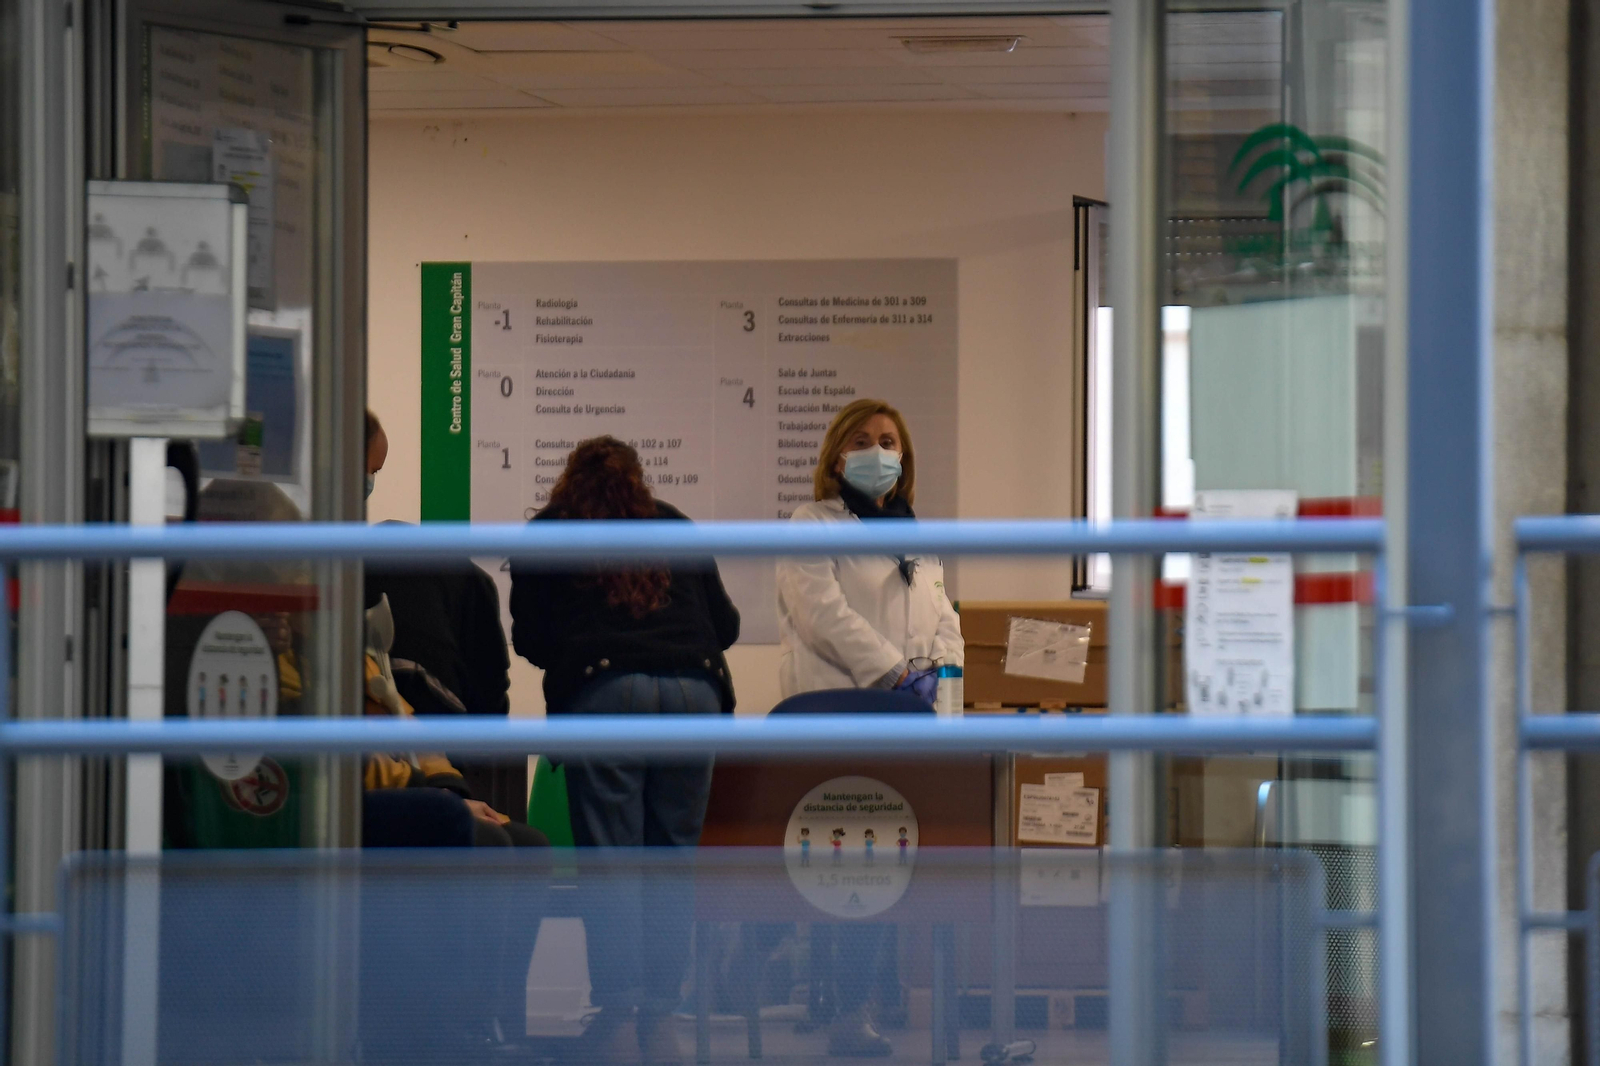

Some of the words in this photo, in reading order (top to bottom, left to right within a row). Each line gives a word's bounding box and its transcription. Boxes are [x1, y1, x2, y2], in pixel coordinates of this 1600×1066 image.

[450, 272, 465, 314] Capitán
[478, 301, 501, 311] Planta
[535, 297, 578, 310] Radiología
[778, 296, 818, 307] Consultas
[820, 296, 830, 307] de
[832, 296, 869, 307] Medicina
[872, 296, 882, 307] de
[884, 296, 900, 307] 301
[902, 299, 908, 307] a
[910, 296, 926, 307] 309
[494, 309, 512, 331] -1
[535, 315, 593, 327] Rehabilitación
[743, 309, 756, 332] 3
[778, 314, 818, 325] Consultas
[820, 314, 830, 325] de
[832, 314, 877, 325] Enfermería
[879, 314, 889, 325] de
[891, 314, 907, 325] 311
[909, 317, 915, 325] a
[917, 314, 932, 325] 314
[450, 316, 462, 342] Gran
[535, 333, 583, 346] Fisioterapia
[778, 331, 830, 343] Extracciones
[450, 347, 462, 377] Salud
[478, 369, 501, 378] Planta
[535, 368, 571, 380] Atención
[573, 371, 579, 380] a
[580, 369, 588, 380] la
[590, 368, 635, 380] Ciudadanía
[778, 367, 796, 379] Sala
[798, 367, 808, 379] de
[810, 367, 837, 379] Juntas
[450, 380, 462, 394] de
[500, 376, 513, 398] 0
[535, 386, 574, 397] Dirección
[778, 385, 809, 396] Escuela
[811, 385, 822, 396] de
[824, 385, 855, 398] Espalda
[742, 387, 756, 409] 4
[450, 396, 462, 432] Centro
[535, 403, 571, 415] Consulta
[573, 403, 583, 415] de
[585, 403, 626, 417] Urgencias
[778, 402, 820, 414] Educación
[778, 420, 826, 432] Trabajadora
[478, 439, 501, 449] Planta
[535, 438, 575, 449] Consultas
[641, 438, 657, 449] 102
[659, 440, 665, 449] a
[667, 438, 683, 449] 107
[777, 438, 818, 449] Biblioteca
[500, 447, 511, 469] 1
[534, 456, 568, 467] Consult
[653, 456, 668, 467] 114
[777, 456, 807, 468] Cirugía
[657, 474, 674, 485] 108
[675, 476, 681, 487] y
[682, 474, 699, 485] 109
[823, 793, 873, 803] Mantengan
[875, 792, 884, 800] la
[803, 803, 844, 812] distancia
[846, 803, 858, 811] de
[859, 802, 904, 813] seguridad
[817, 873, 839, 888] 1,5
[842, 873, 892, 887] metros
